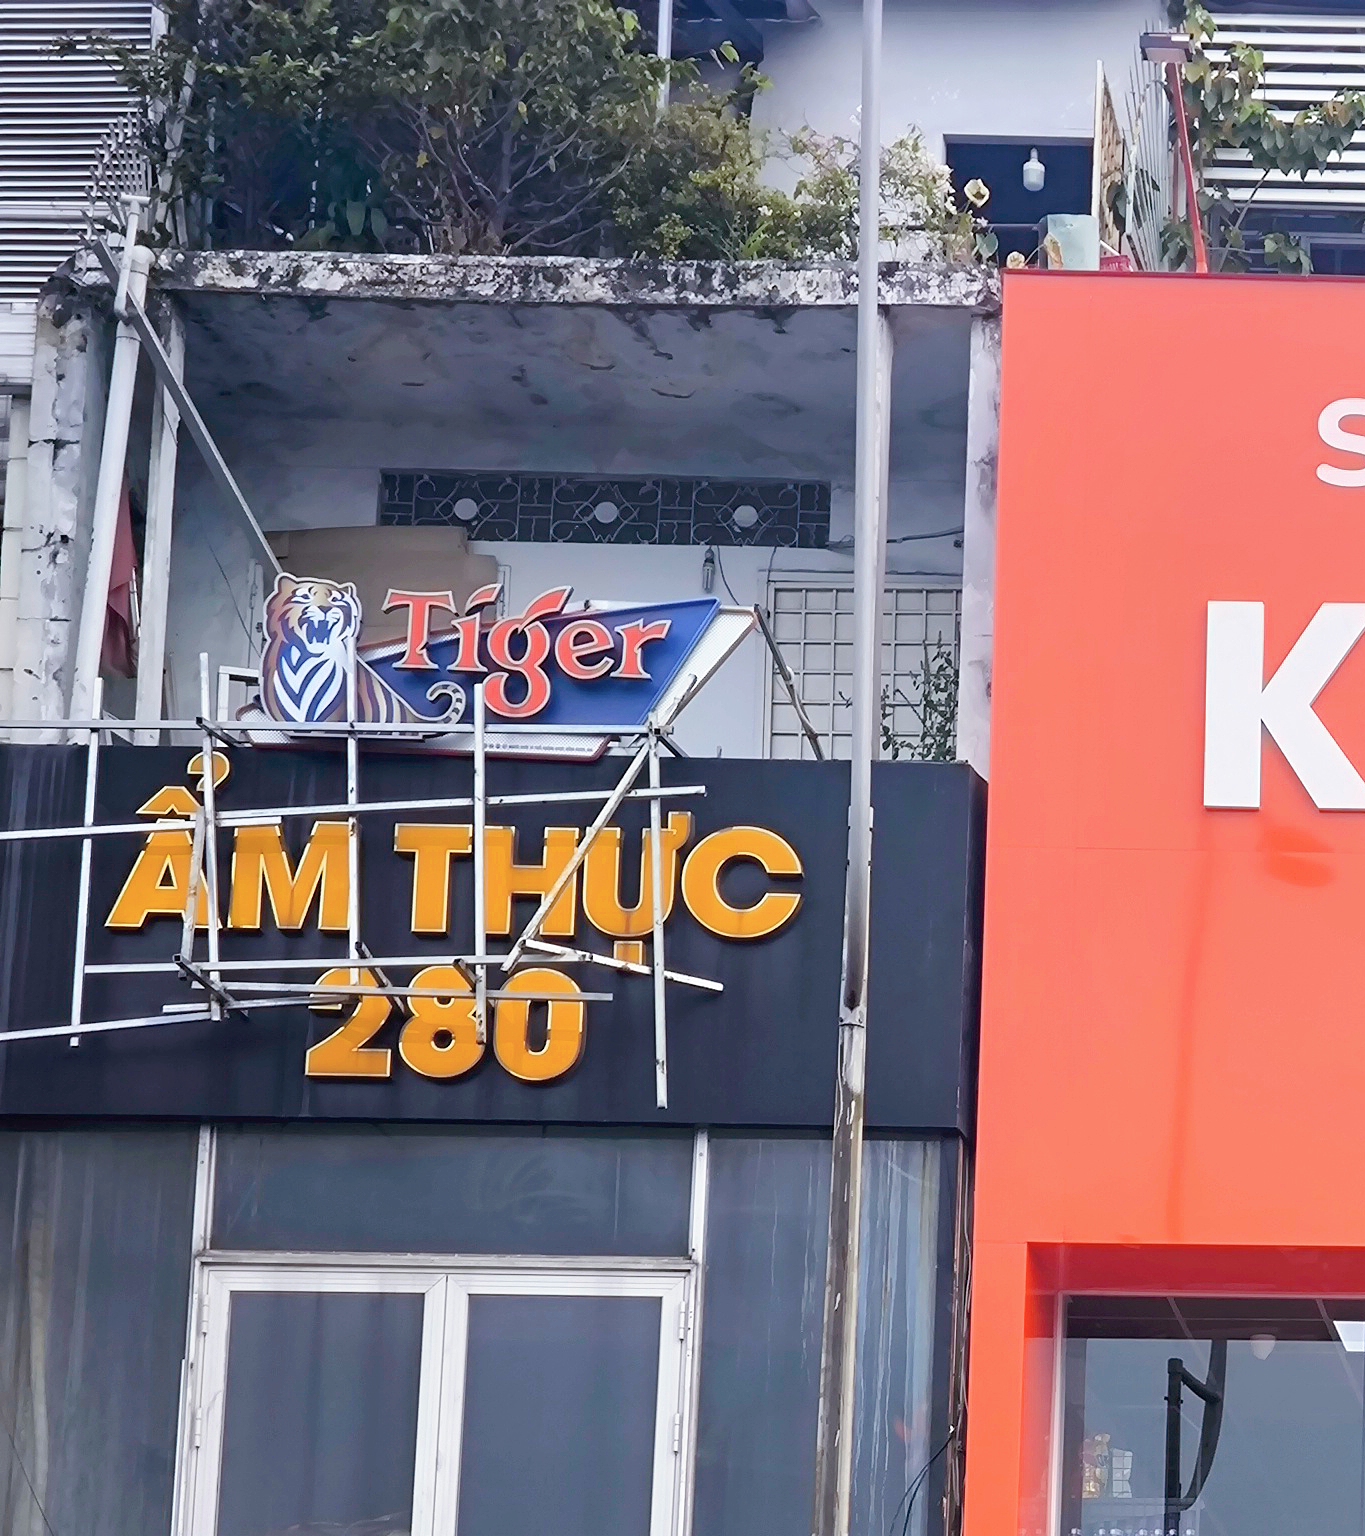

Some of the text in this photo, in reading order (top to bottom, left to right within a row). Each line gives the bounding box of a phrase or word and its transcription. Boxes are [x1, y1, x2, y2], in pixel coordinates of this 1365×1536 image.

[383, 584, 671, 719] Tiger
[105, 751, 804, 972] ẨM THỰC
[304, 966, 587, 1082] 280
